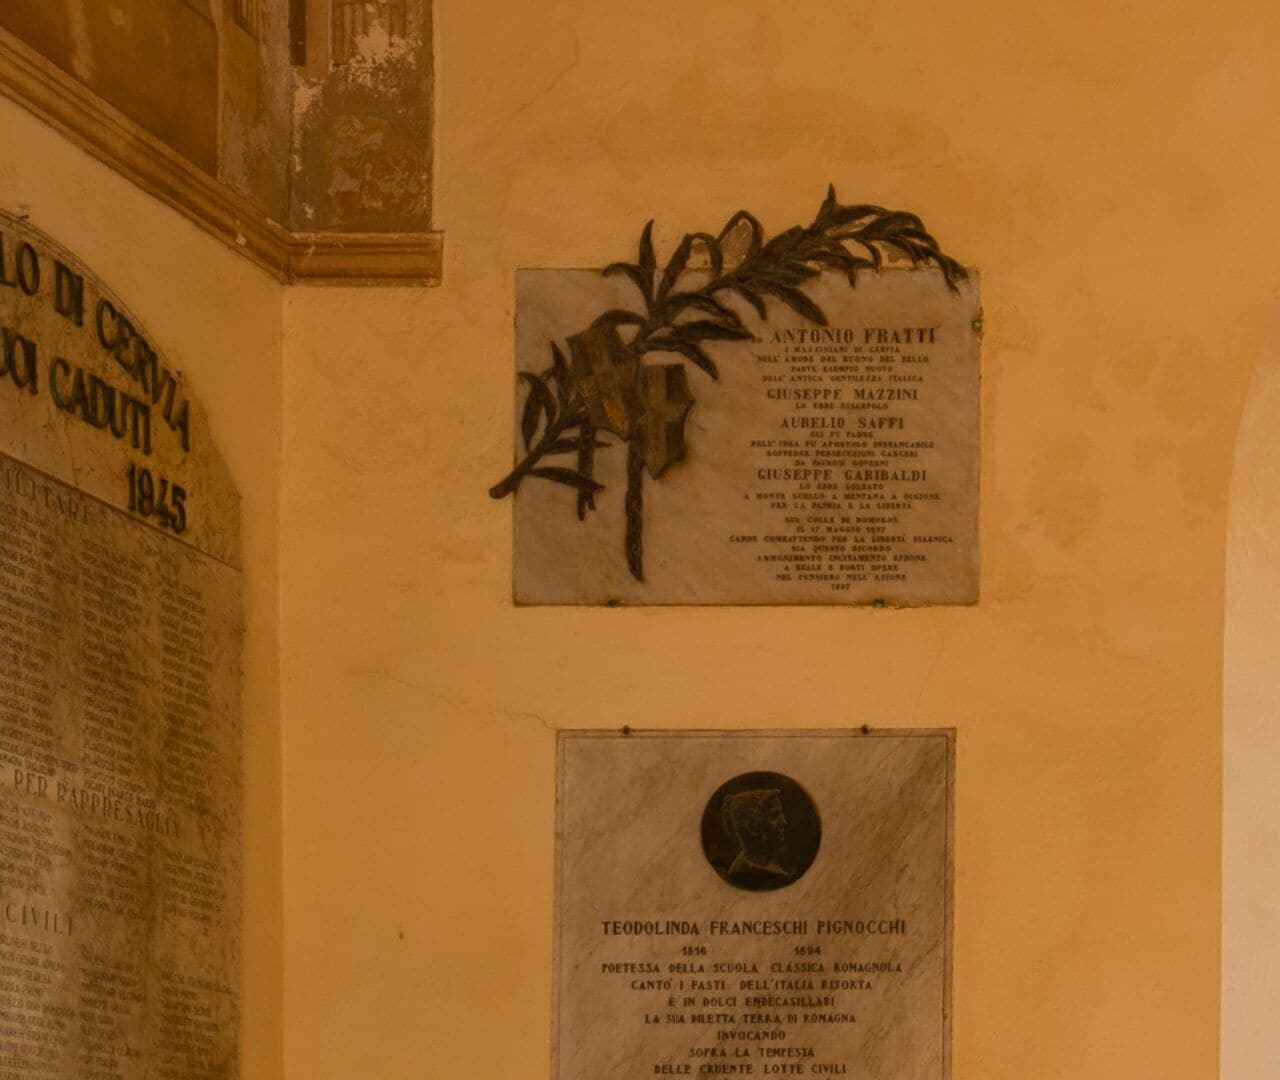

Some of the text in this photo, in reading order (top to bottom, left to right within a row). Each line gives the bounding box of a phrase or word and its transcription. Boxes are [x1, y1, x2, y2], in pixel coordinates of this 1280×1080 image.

[770, 328, 936, 343] ANTONIO FRATTI
[54, 258, 84, 328] DI
[96, 297, 190, 452] CERVIA
[767, 389, 918, 400] GIUSEPPE MAZZINI
[49, 356, 152, 456] CADUTI
[781, 417, 904, 429] AURELIO SAFFI
[757, 469, 927, 481] GIUSEPPE GARIBALDI
[14, 768, 180, 840] PER RAPPRESAGLIA
[5, 902, 74, 937] CIVILI
[602, 920, 906, 936] TEODOLINDA FRANCESCHI PIGNOCCHI
[602, 963, 902, 973] POETESSA DELLA SCUOLA CLASSICA ROMAGNOLA
[691, 980, 725, 990] FASTI
[821, 980, 872, 990] RISORTA
[668, 997, 835, 1007] E IN DOLCI ENDECASILLABI
[645, 1014, 856, 1024] LA SUA DILETTA TERRA DI ROMAGNA
[717, 1030, 786, 1041] INVOCANDO
[689, 1048, 815, 1058] SOPRA LA TEMPESTA
[654, 1064, 846, 1075] DELLE CRUENTE LOTTE CIVILI
